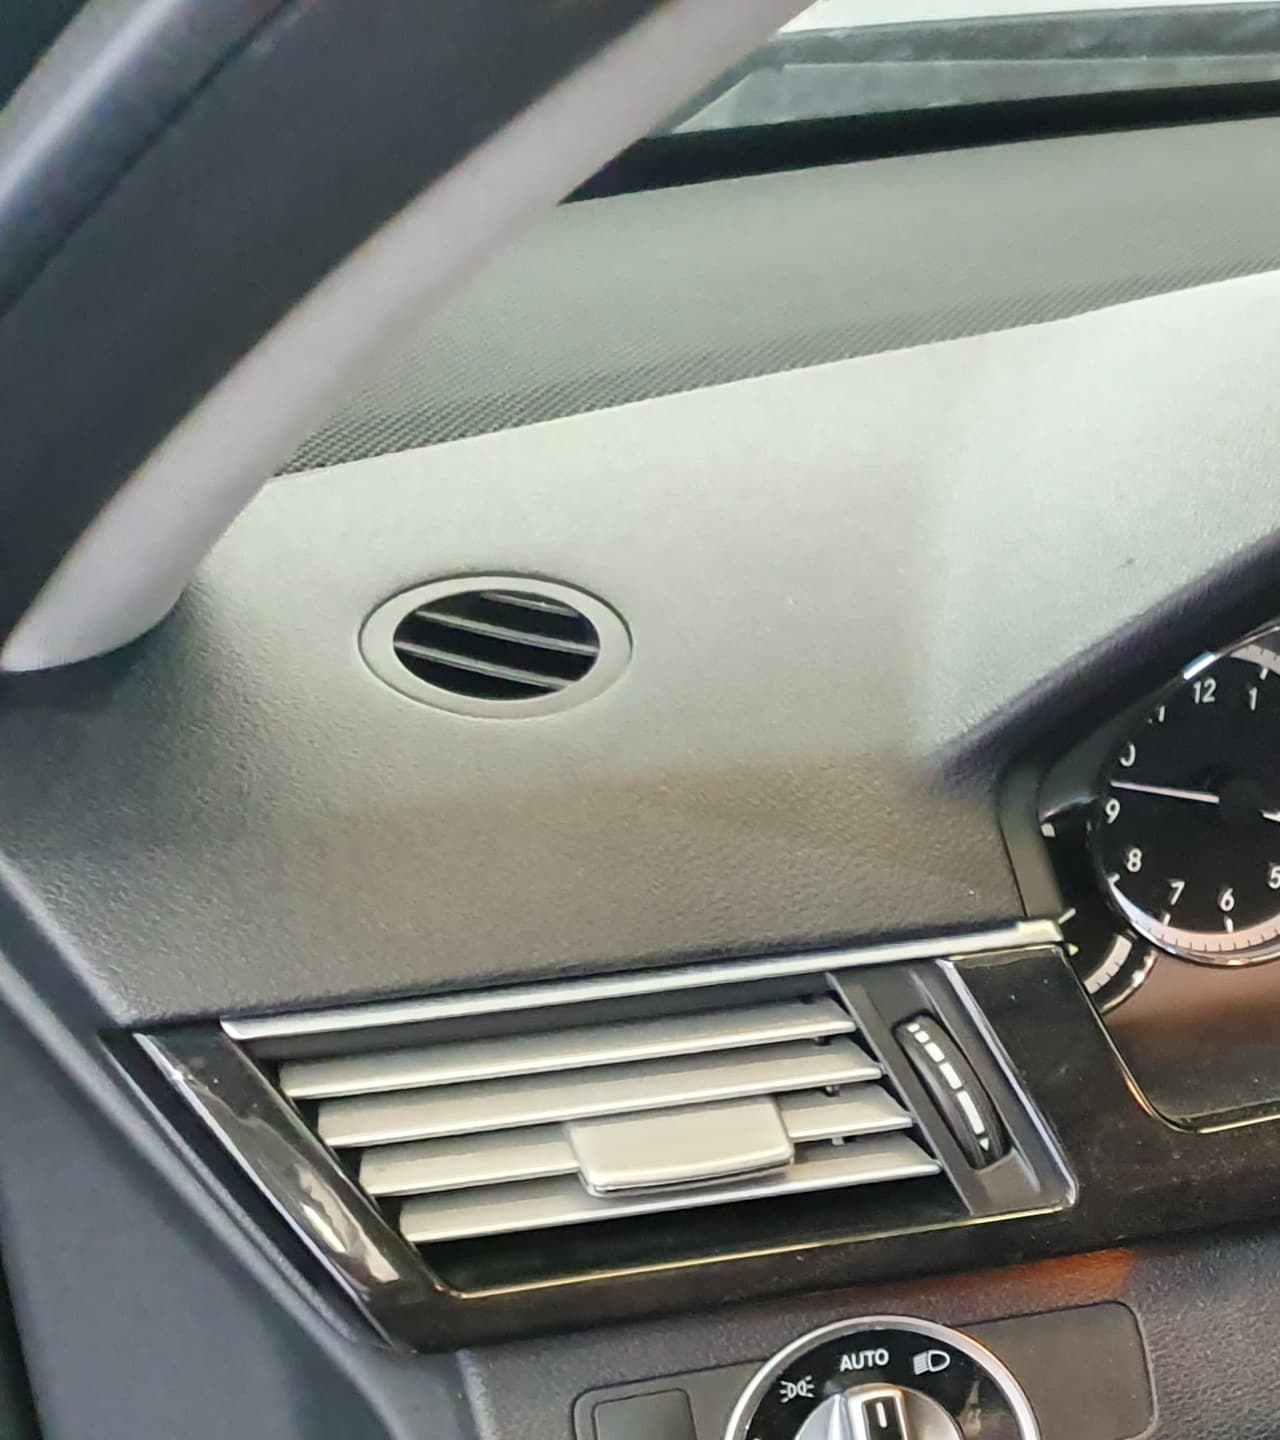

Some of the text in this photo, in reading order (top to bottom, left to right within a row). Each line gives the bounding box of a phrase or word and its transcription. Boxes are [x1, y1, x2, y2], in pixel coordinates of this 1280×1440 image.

[1193, 678, 1216, 704] 12
[1249, 686, 1258, 711] 1
[1105, 799, 1121, 824] 9
[1126, 848, 1142, 873] 8
[1168, 880, 1185, 906] 7
[1218, 888, 1235, 912] 6
[839, 1348, 889, 1372] AUTO
